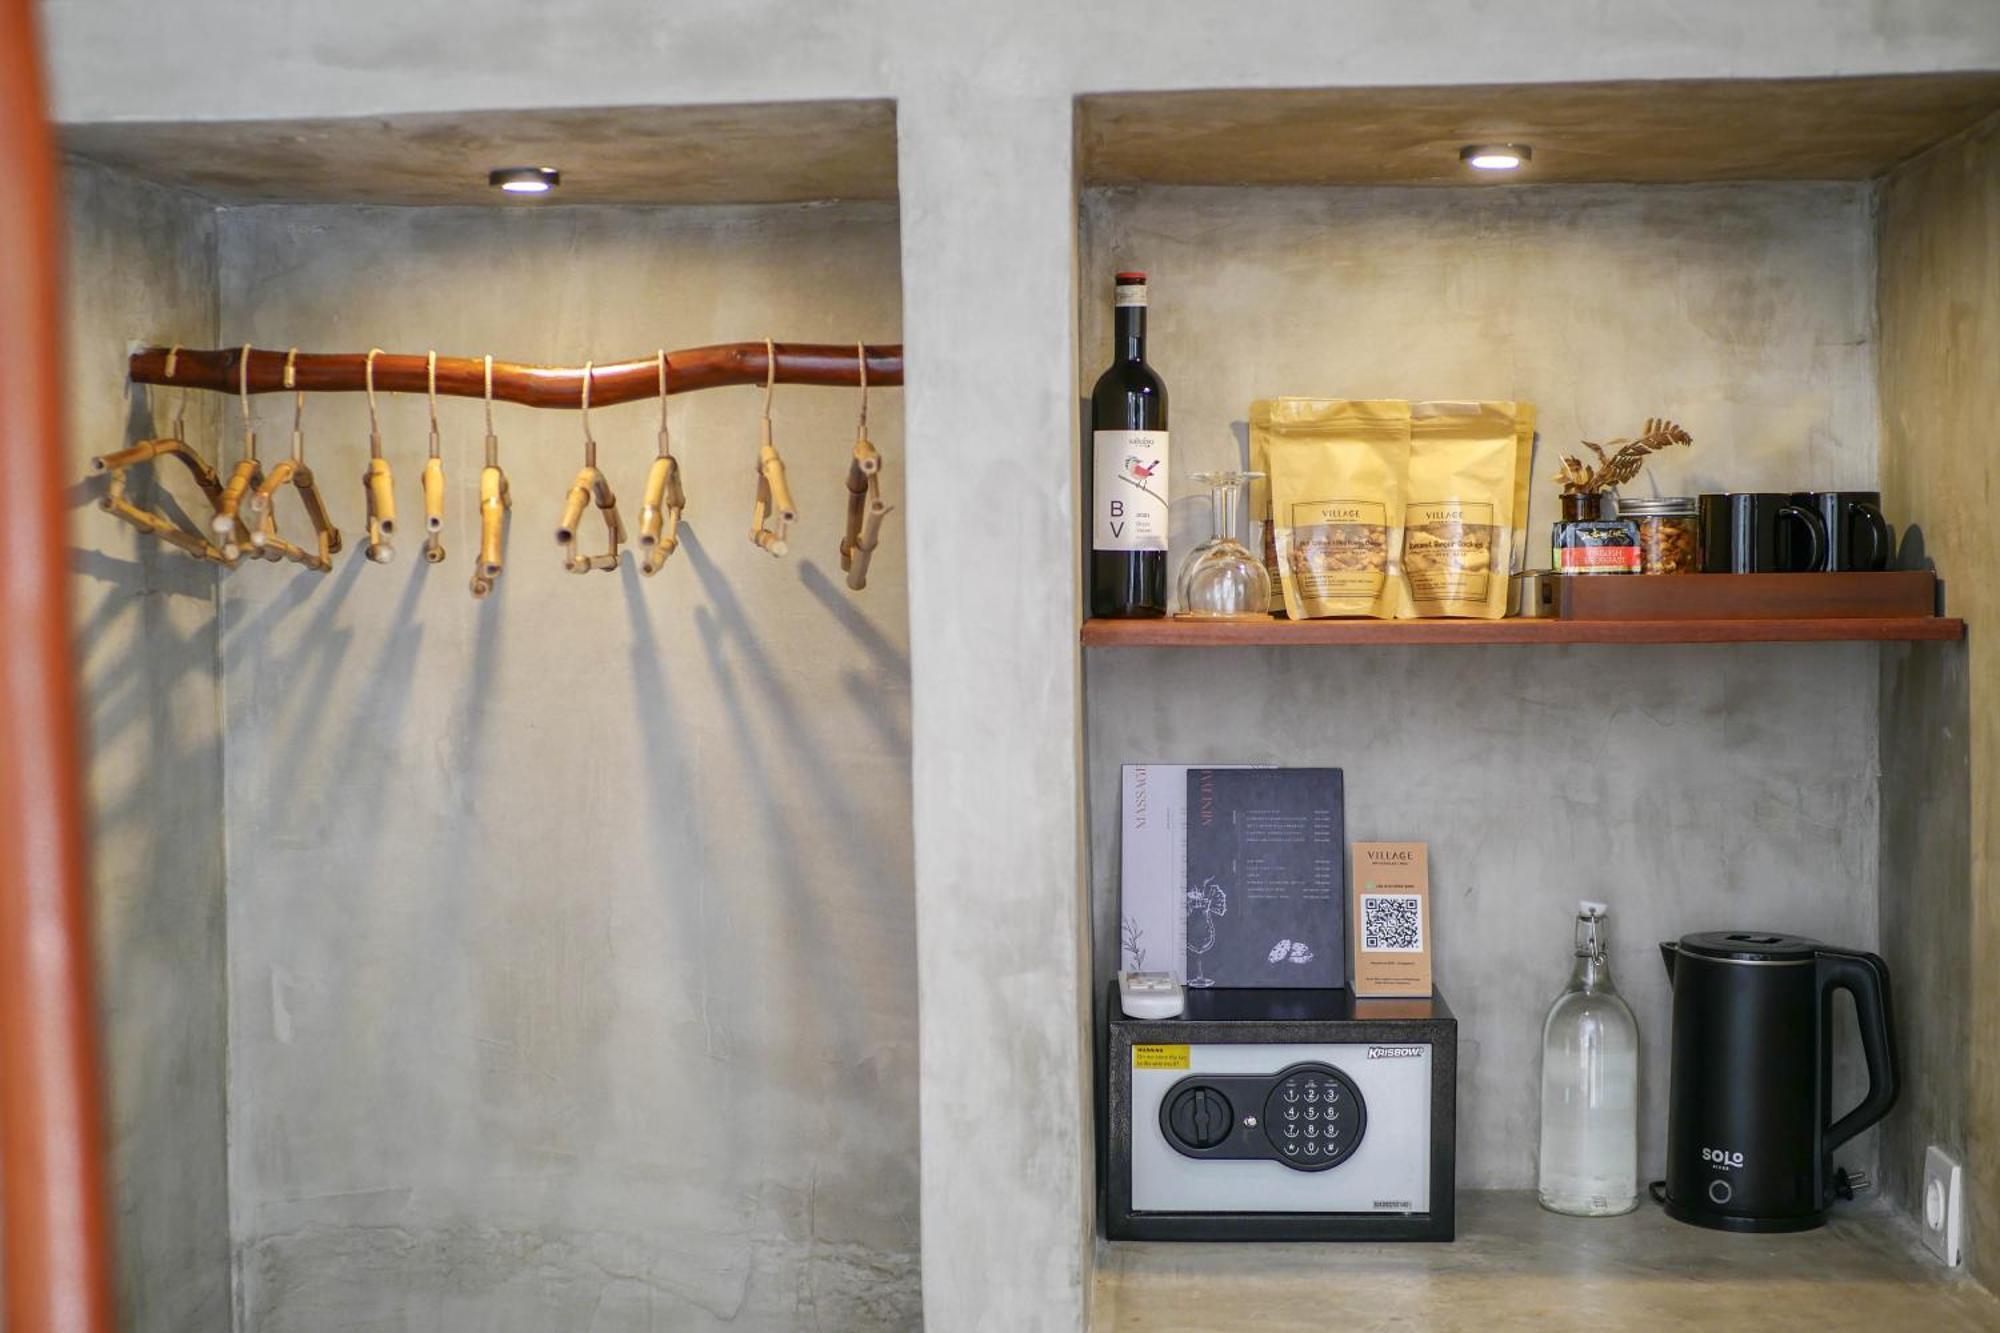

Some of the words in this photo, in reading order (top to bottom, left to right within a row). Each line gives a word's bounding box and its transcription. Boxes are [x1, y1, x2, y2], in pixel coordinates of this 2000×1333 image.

[1111, 501, 1124, 517] B
[1322, 510, 1361, 518] VILLAGE
[1426, 511, 1464, 520] VILLAGE
[1110, 521, 1124, 538] V
[1367, 850, 1414, 861] VILLAGE
[1368, 1047, 1420, 1059] KRISBOW
[1289, 1090, 1293, 1098] 1
[1308, 1090, 1314, 1098] 2
[1328, 1090, 1334, 1098] 3
[1289, 1107, 1294, 1115] 4
[1328, 1107, 1333, 1115] 6
[1328, 1125, 1333, 1133] 9
[1309, 1143, 1314, 1151] 0
[1702, 1147, 1744, 1168] SOLO
